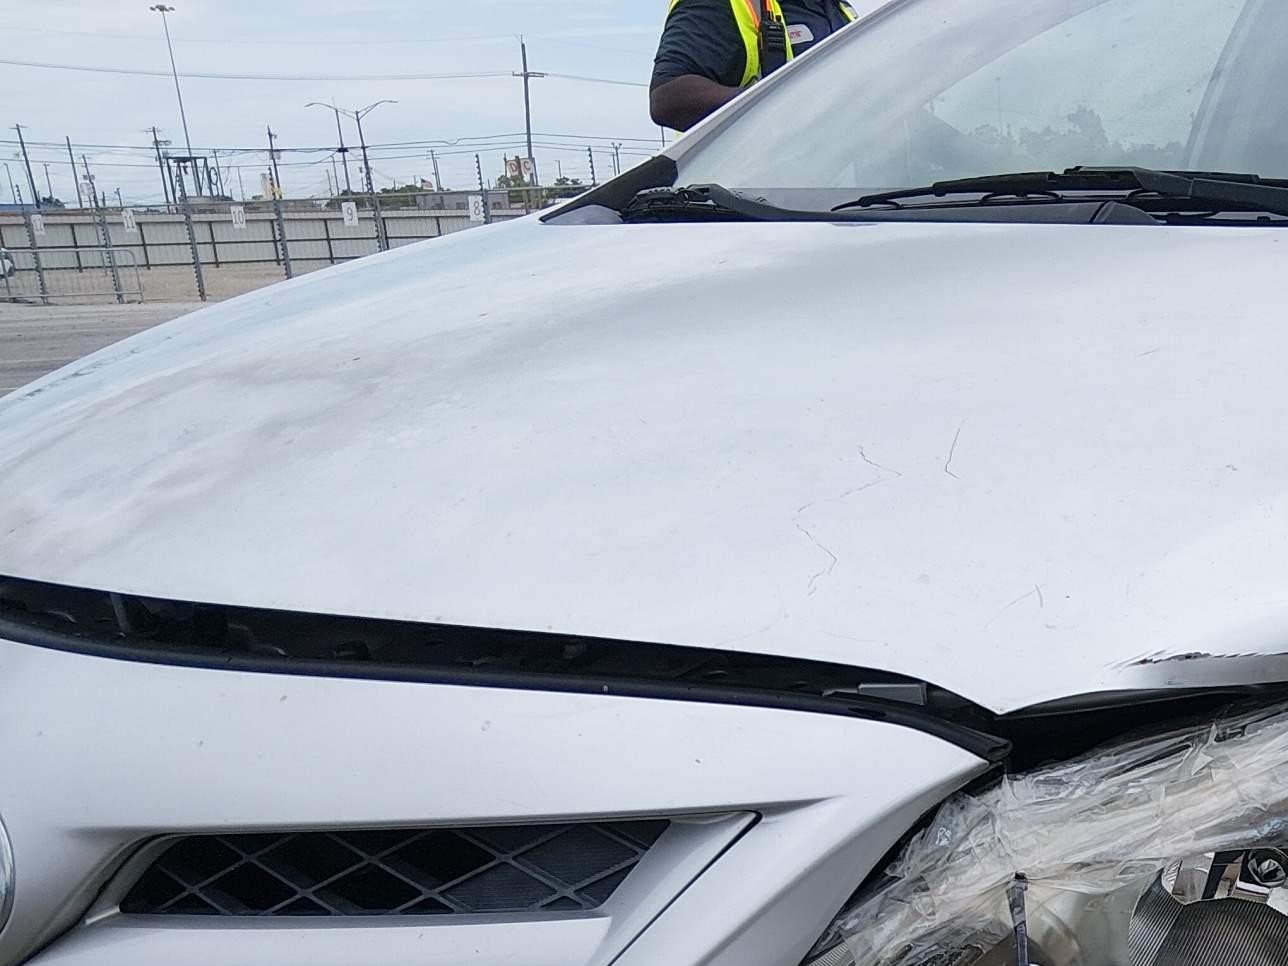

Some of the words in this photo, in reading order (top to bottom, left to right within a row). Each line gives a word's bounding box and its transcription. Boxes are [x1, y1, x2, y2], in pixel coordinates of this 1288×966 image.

[346, 206, 354, 221] 9
[473, 200, 481, 216] 8
[232, 209, 245, 225] 10
